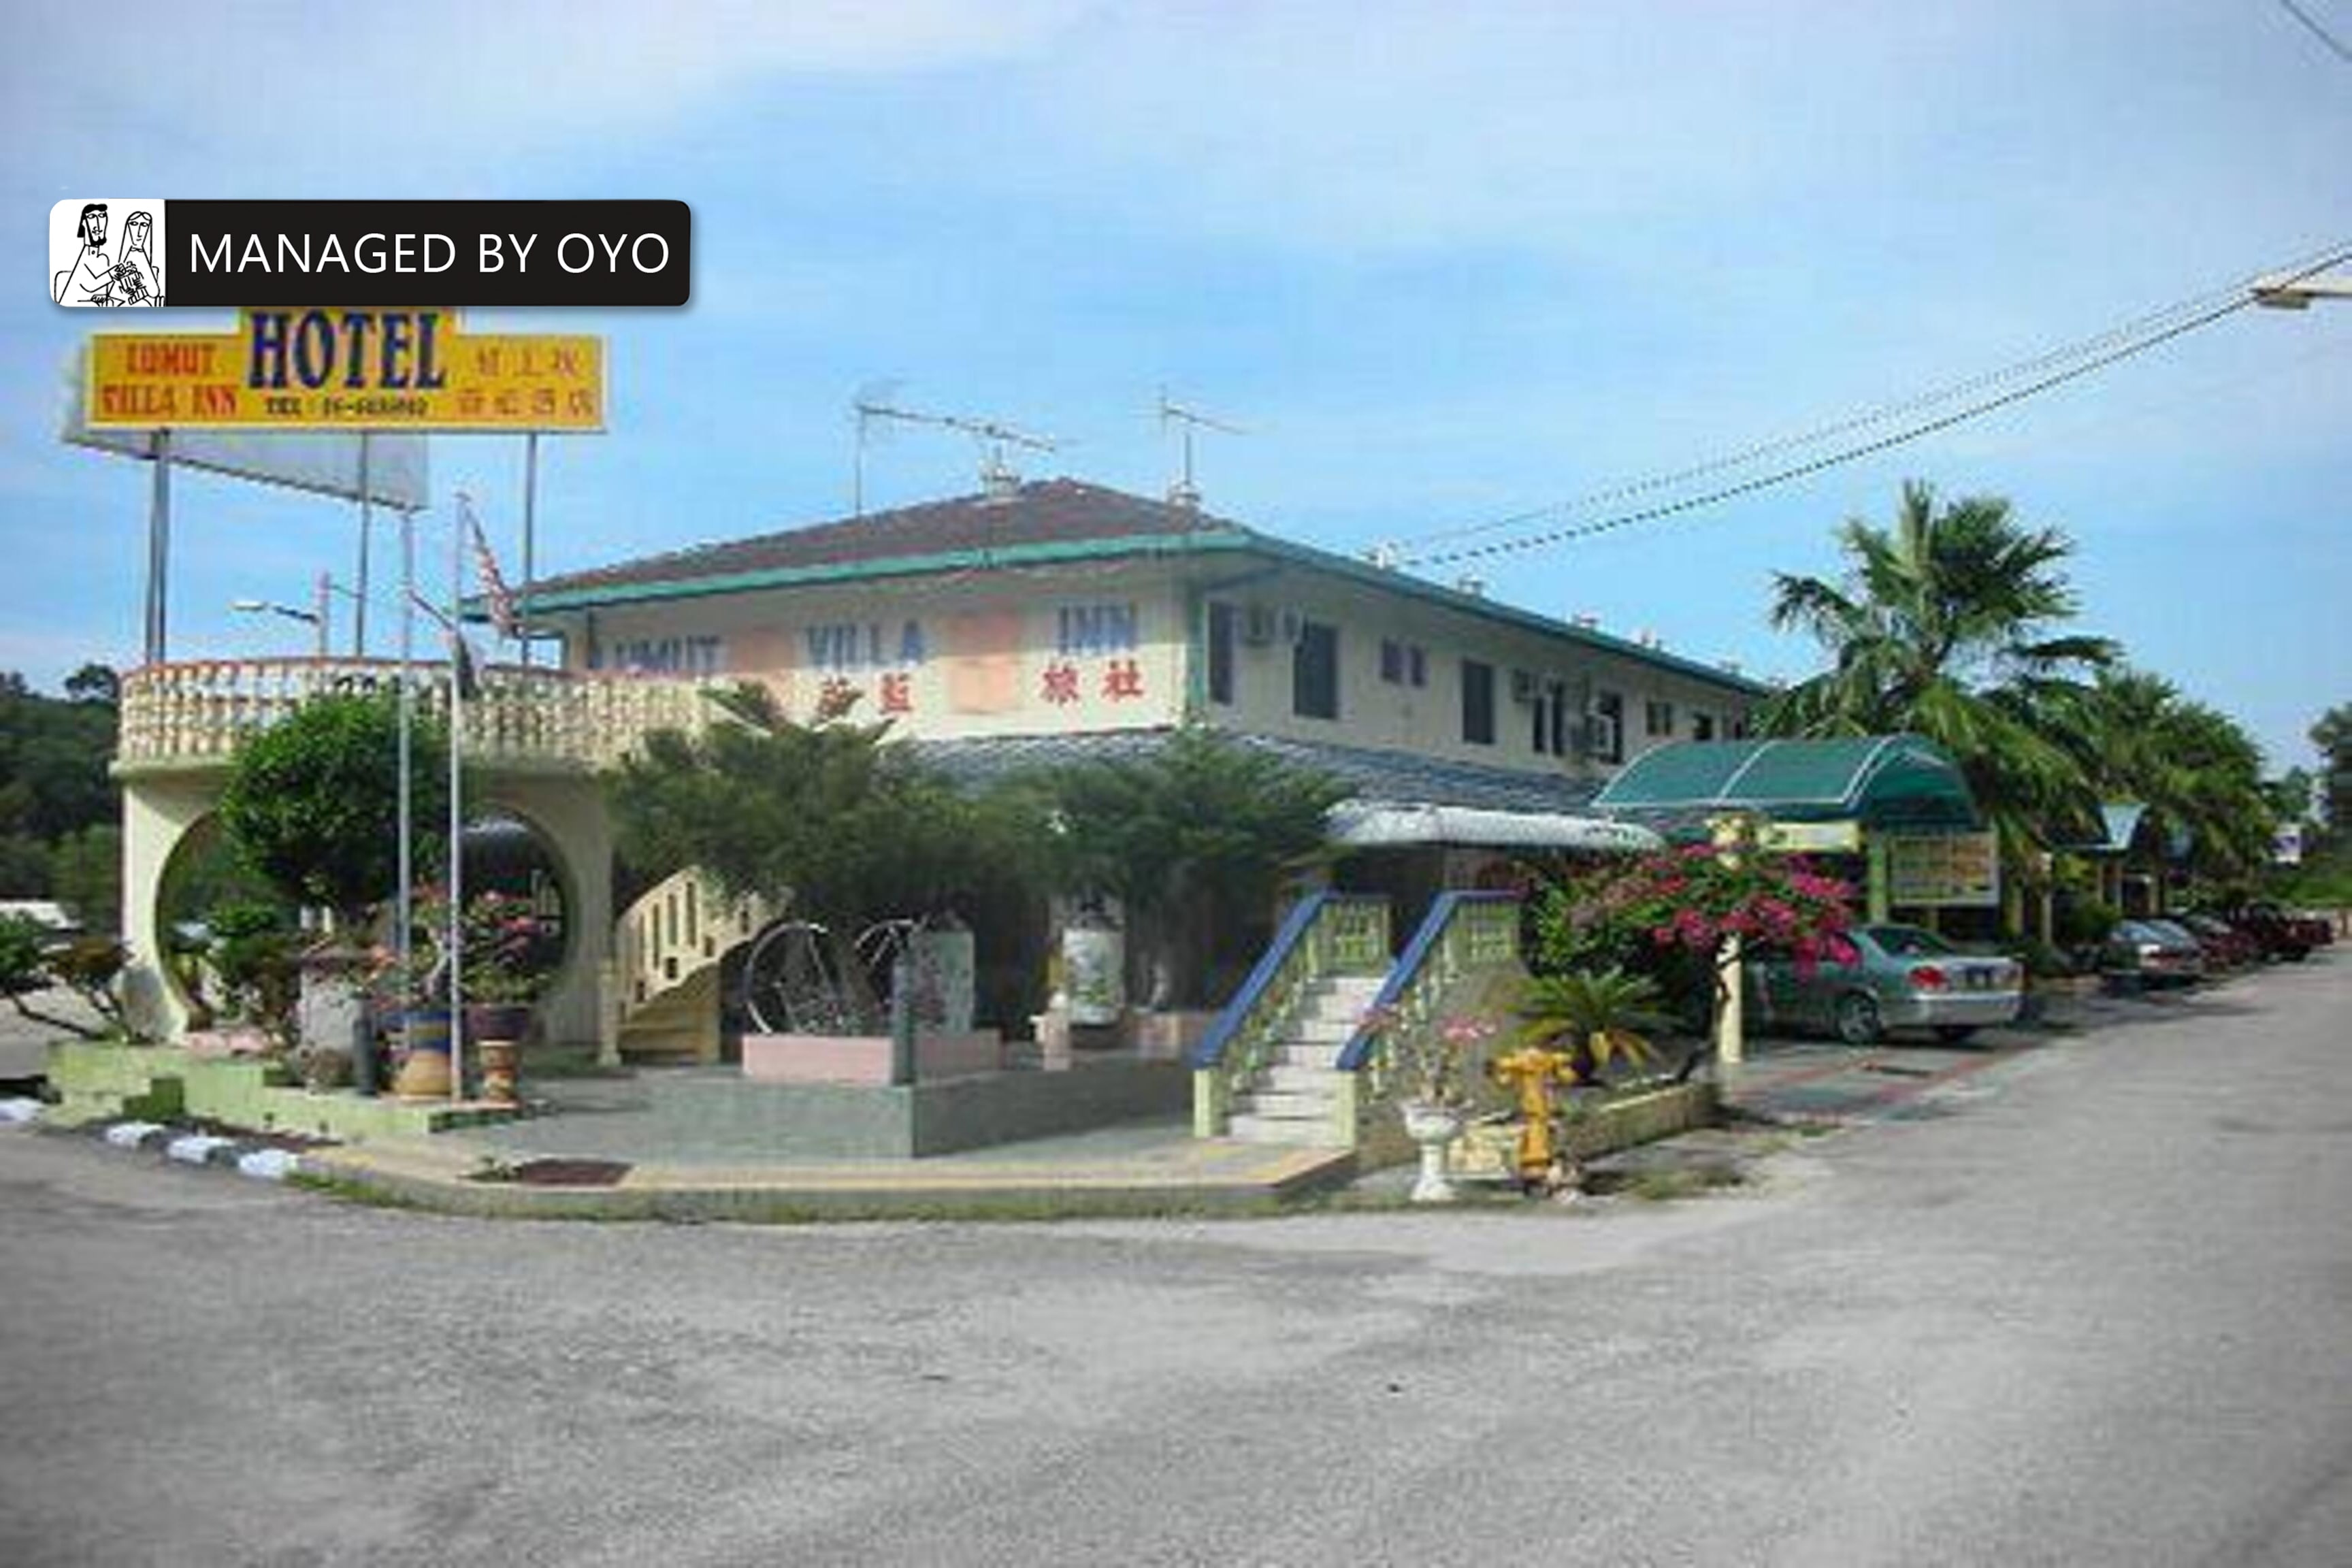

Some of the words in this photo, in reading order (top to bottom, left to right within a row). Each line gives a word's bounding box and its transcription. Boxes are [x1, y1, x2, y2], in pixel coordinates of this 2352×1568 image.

[249, 310, 446, 388] HOTEL
[192, 385, 238, 415] INN
[806, 622, 925, 670] VILLA
[1059, 603, 1137, 656] INN
